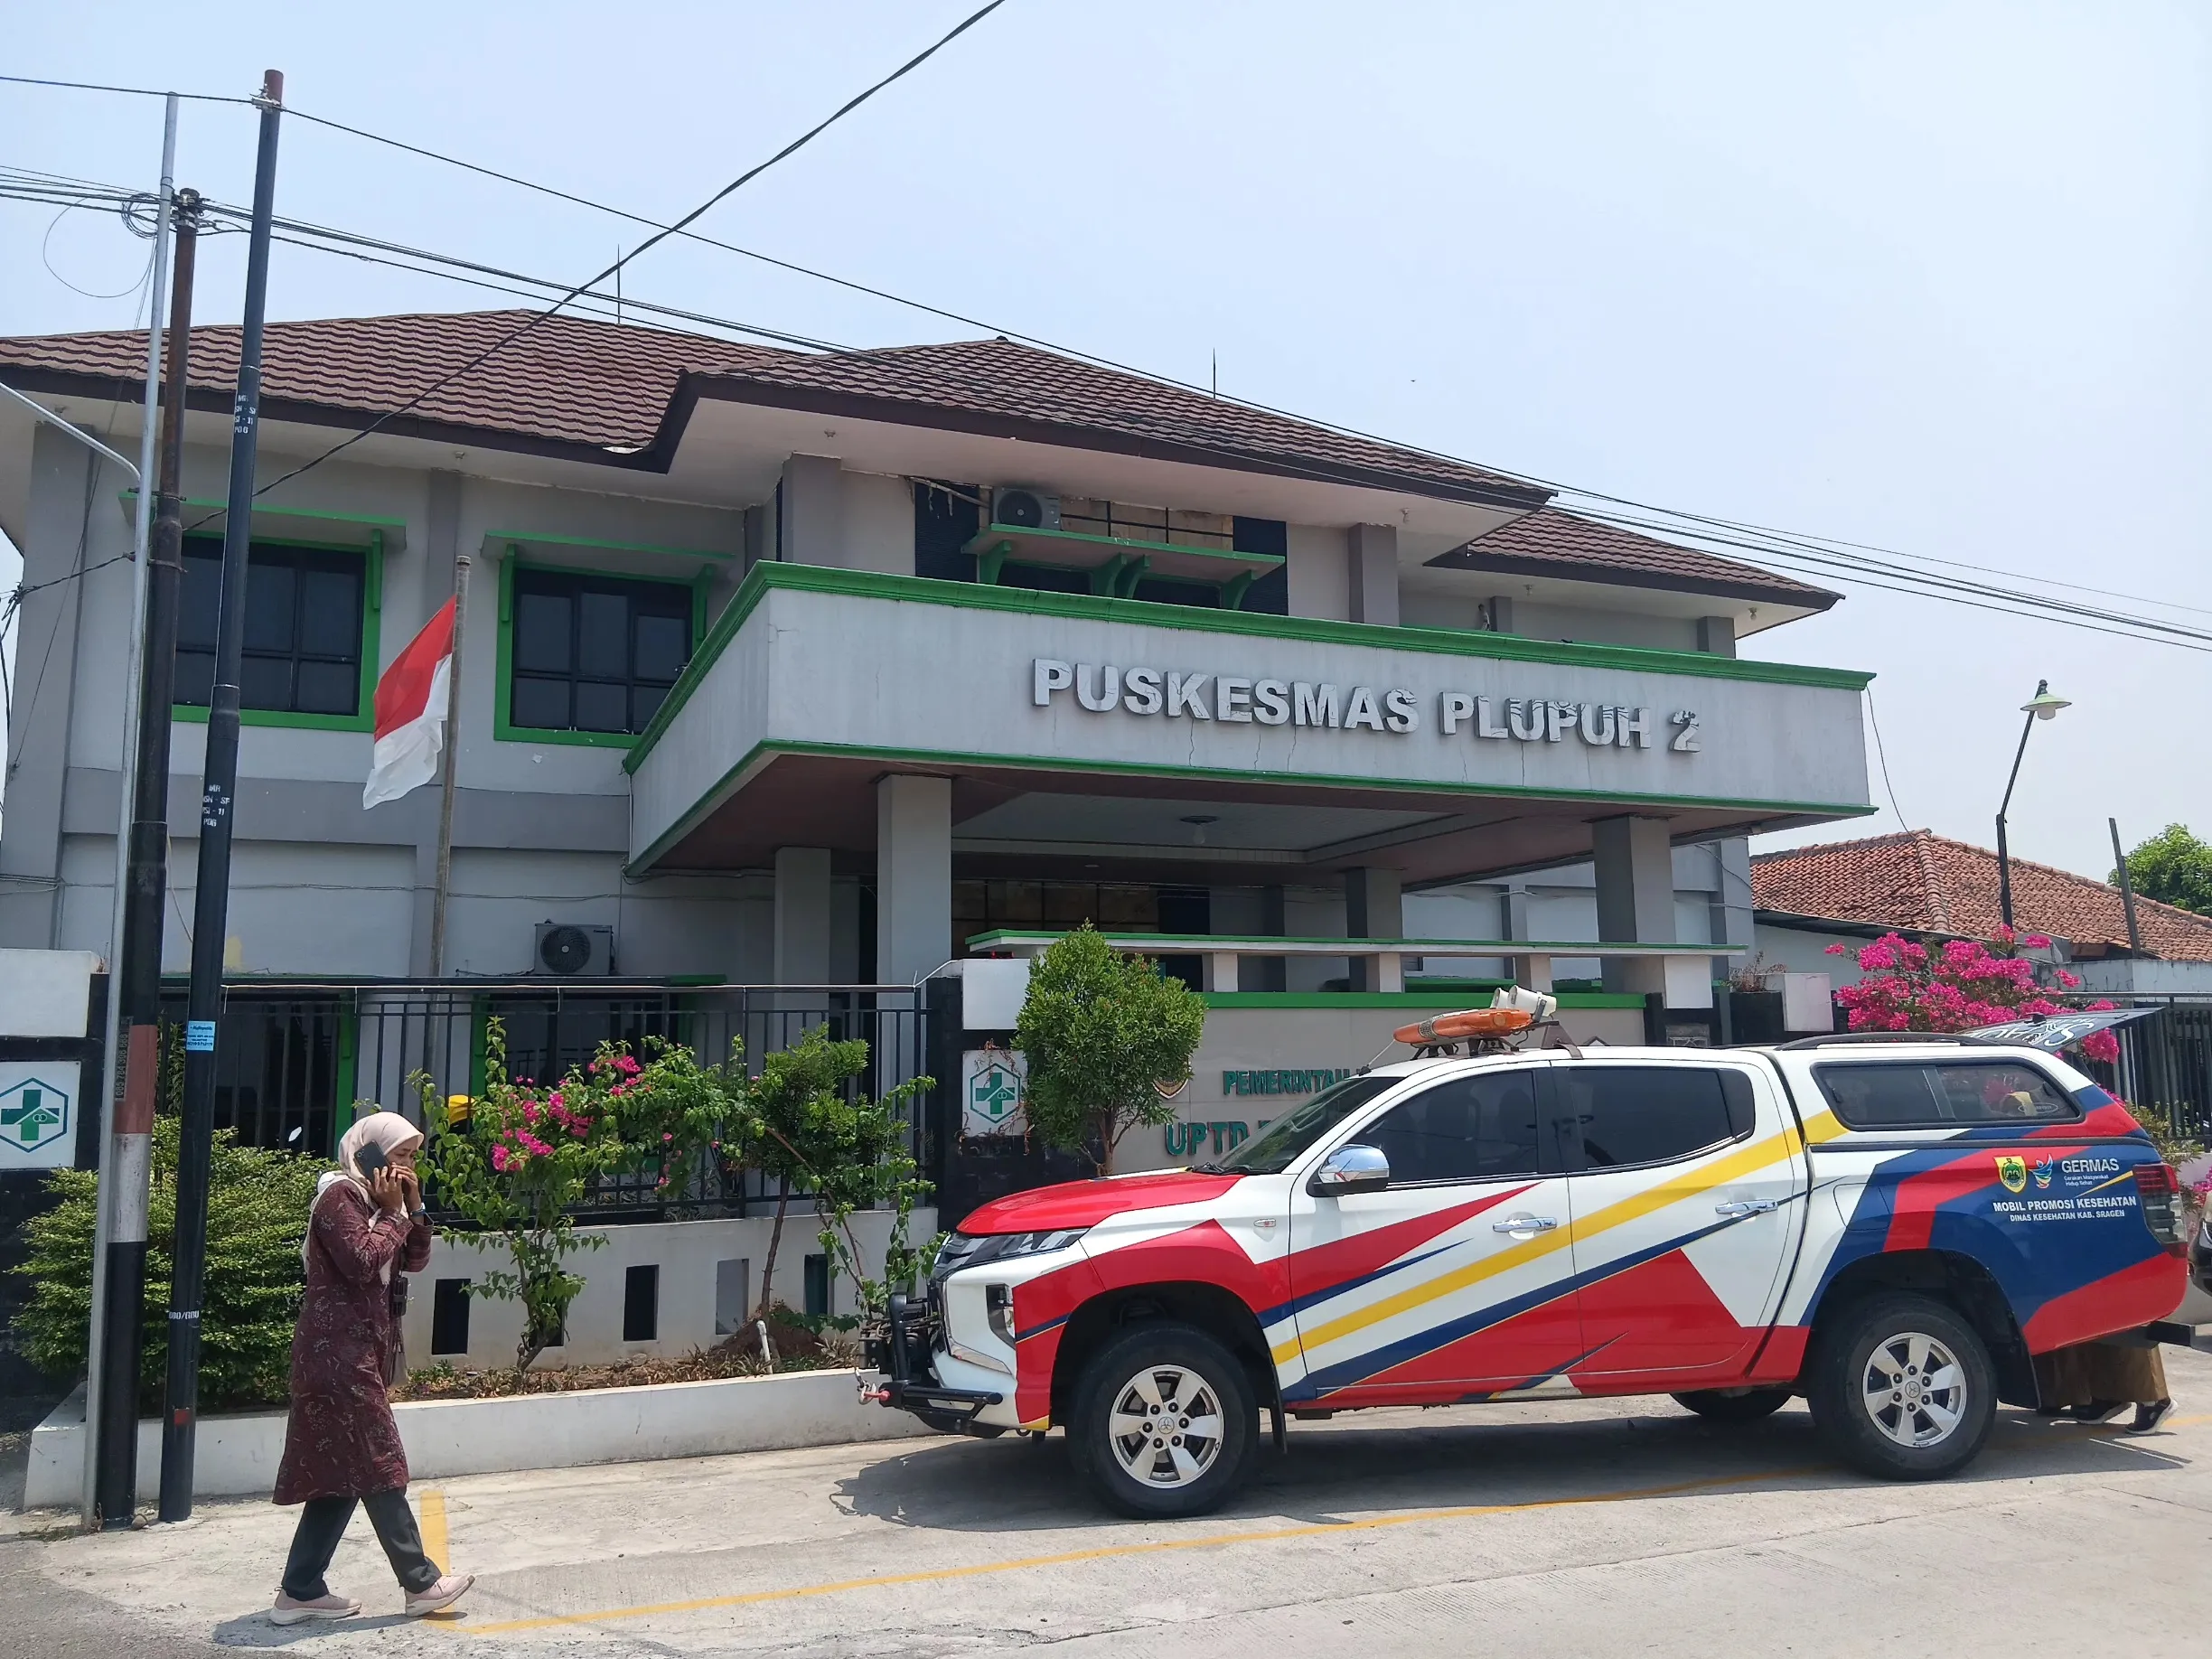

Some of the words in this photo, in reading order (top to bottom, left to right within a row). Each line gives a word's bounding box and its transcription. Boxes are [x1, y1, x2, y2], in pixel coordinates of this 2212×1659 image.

[1031, 658, 1420, 735] PUSKESMAS
[1439, 690, 1653, 749] PLUPUH
[1668, 708, 1701, 753] 2
[1165, 1120, 1251, 1156] UPTD
[2061, 1158, 2120, 1173] GERMAS
[1992, 1201, 2026, 1212] MOBIL
[2027, 1198, 2075, 1211] PROMOSI
[2076, 1195, 2137, 1209] KESEHATAN
[2010, 1214, 2032, 1222] DINAS
[2033, 1212, 2076, 1221] KESEHATAN
[2076, 1211, 2095, 1219] KAB.
[2096, 1209, 2125, 1218] SRAGEN
